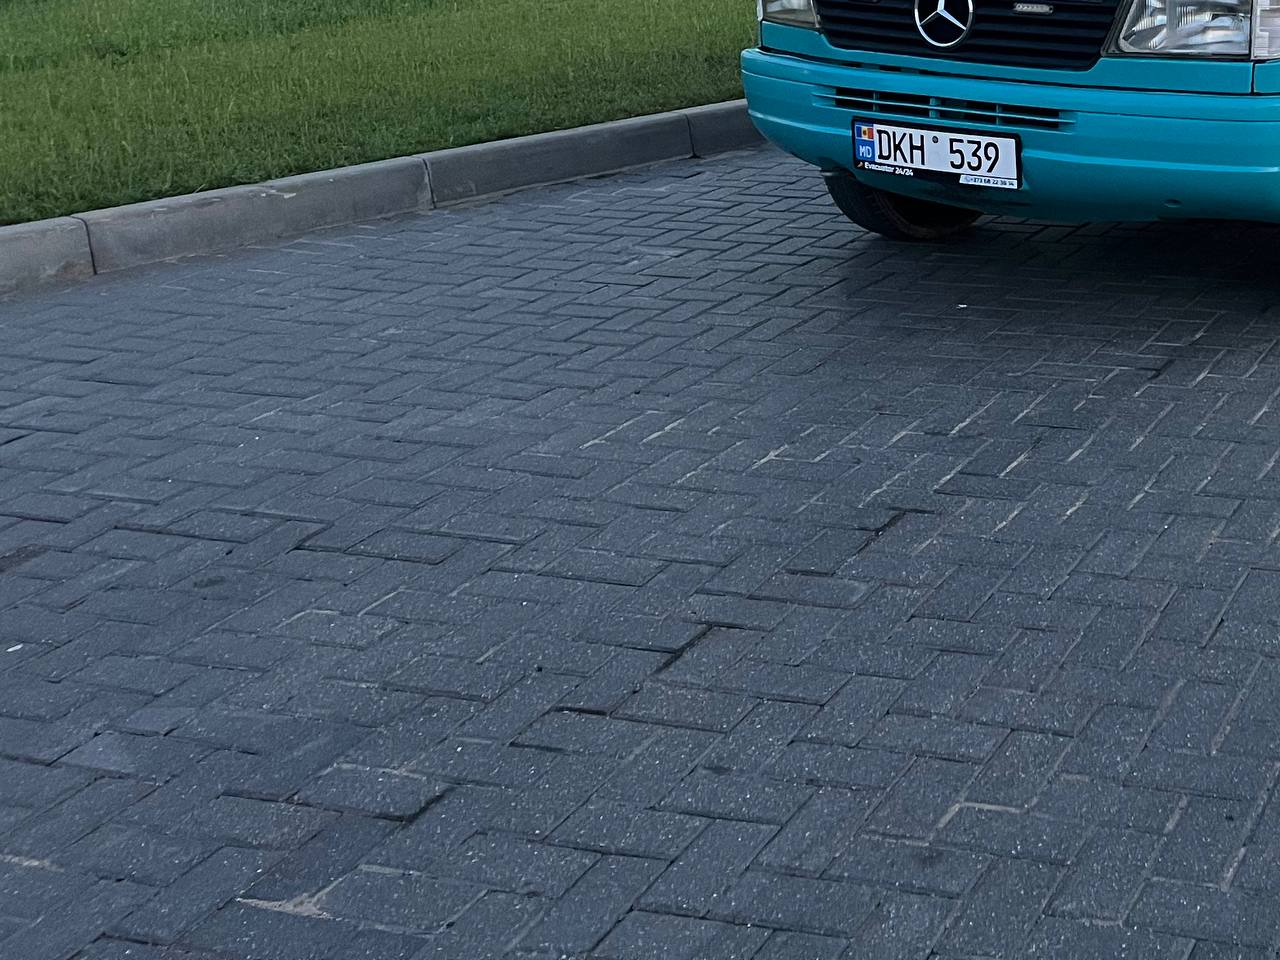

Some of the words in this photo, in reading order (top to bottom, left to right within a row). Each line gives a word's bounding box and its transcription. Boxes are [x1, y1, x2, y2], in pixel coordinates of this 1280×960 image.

[859, 145, 872, 159] MD
[876, 129, 926, 166] DKH
[949, 138, 1000, 174] 539
